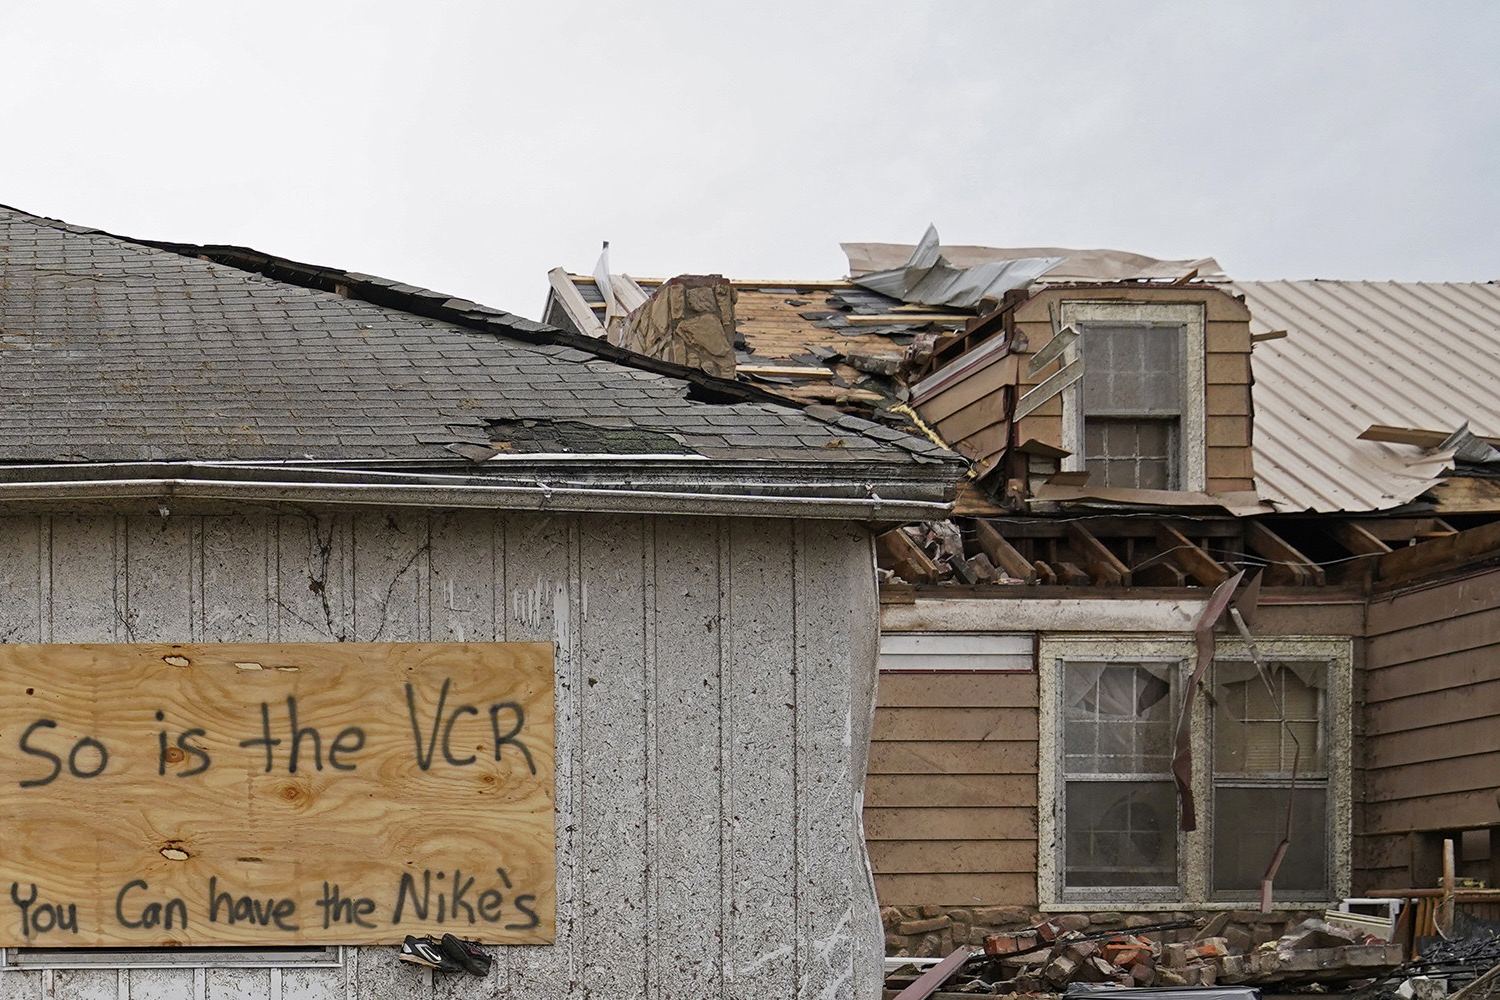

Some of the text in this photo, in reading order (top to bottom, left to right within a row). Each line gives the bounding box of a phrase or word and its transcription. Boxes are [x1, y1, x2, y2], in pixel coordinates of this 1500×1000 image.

[18, 677, 538, 788] So is the VCR
[10, 881, 79, 937] You
[114, 879, 189, 930] Can
[207, 876, 300, 932] have
[316, 880, 378, 930] the
